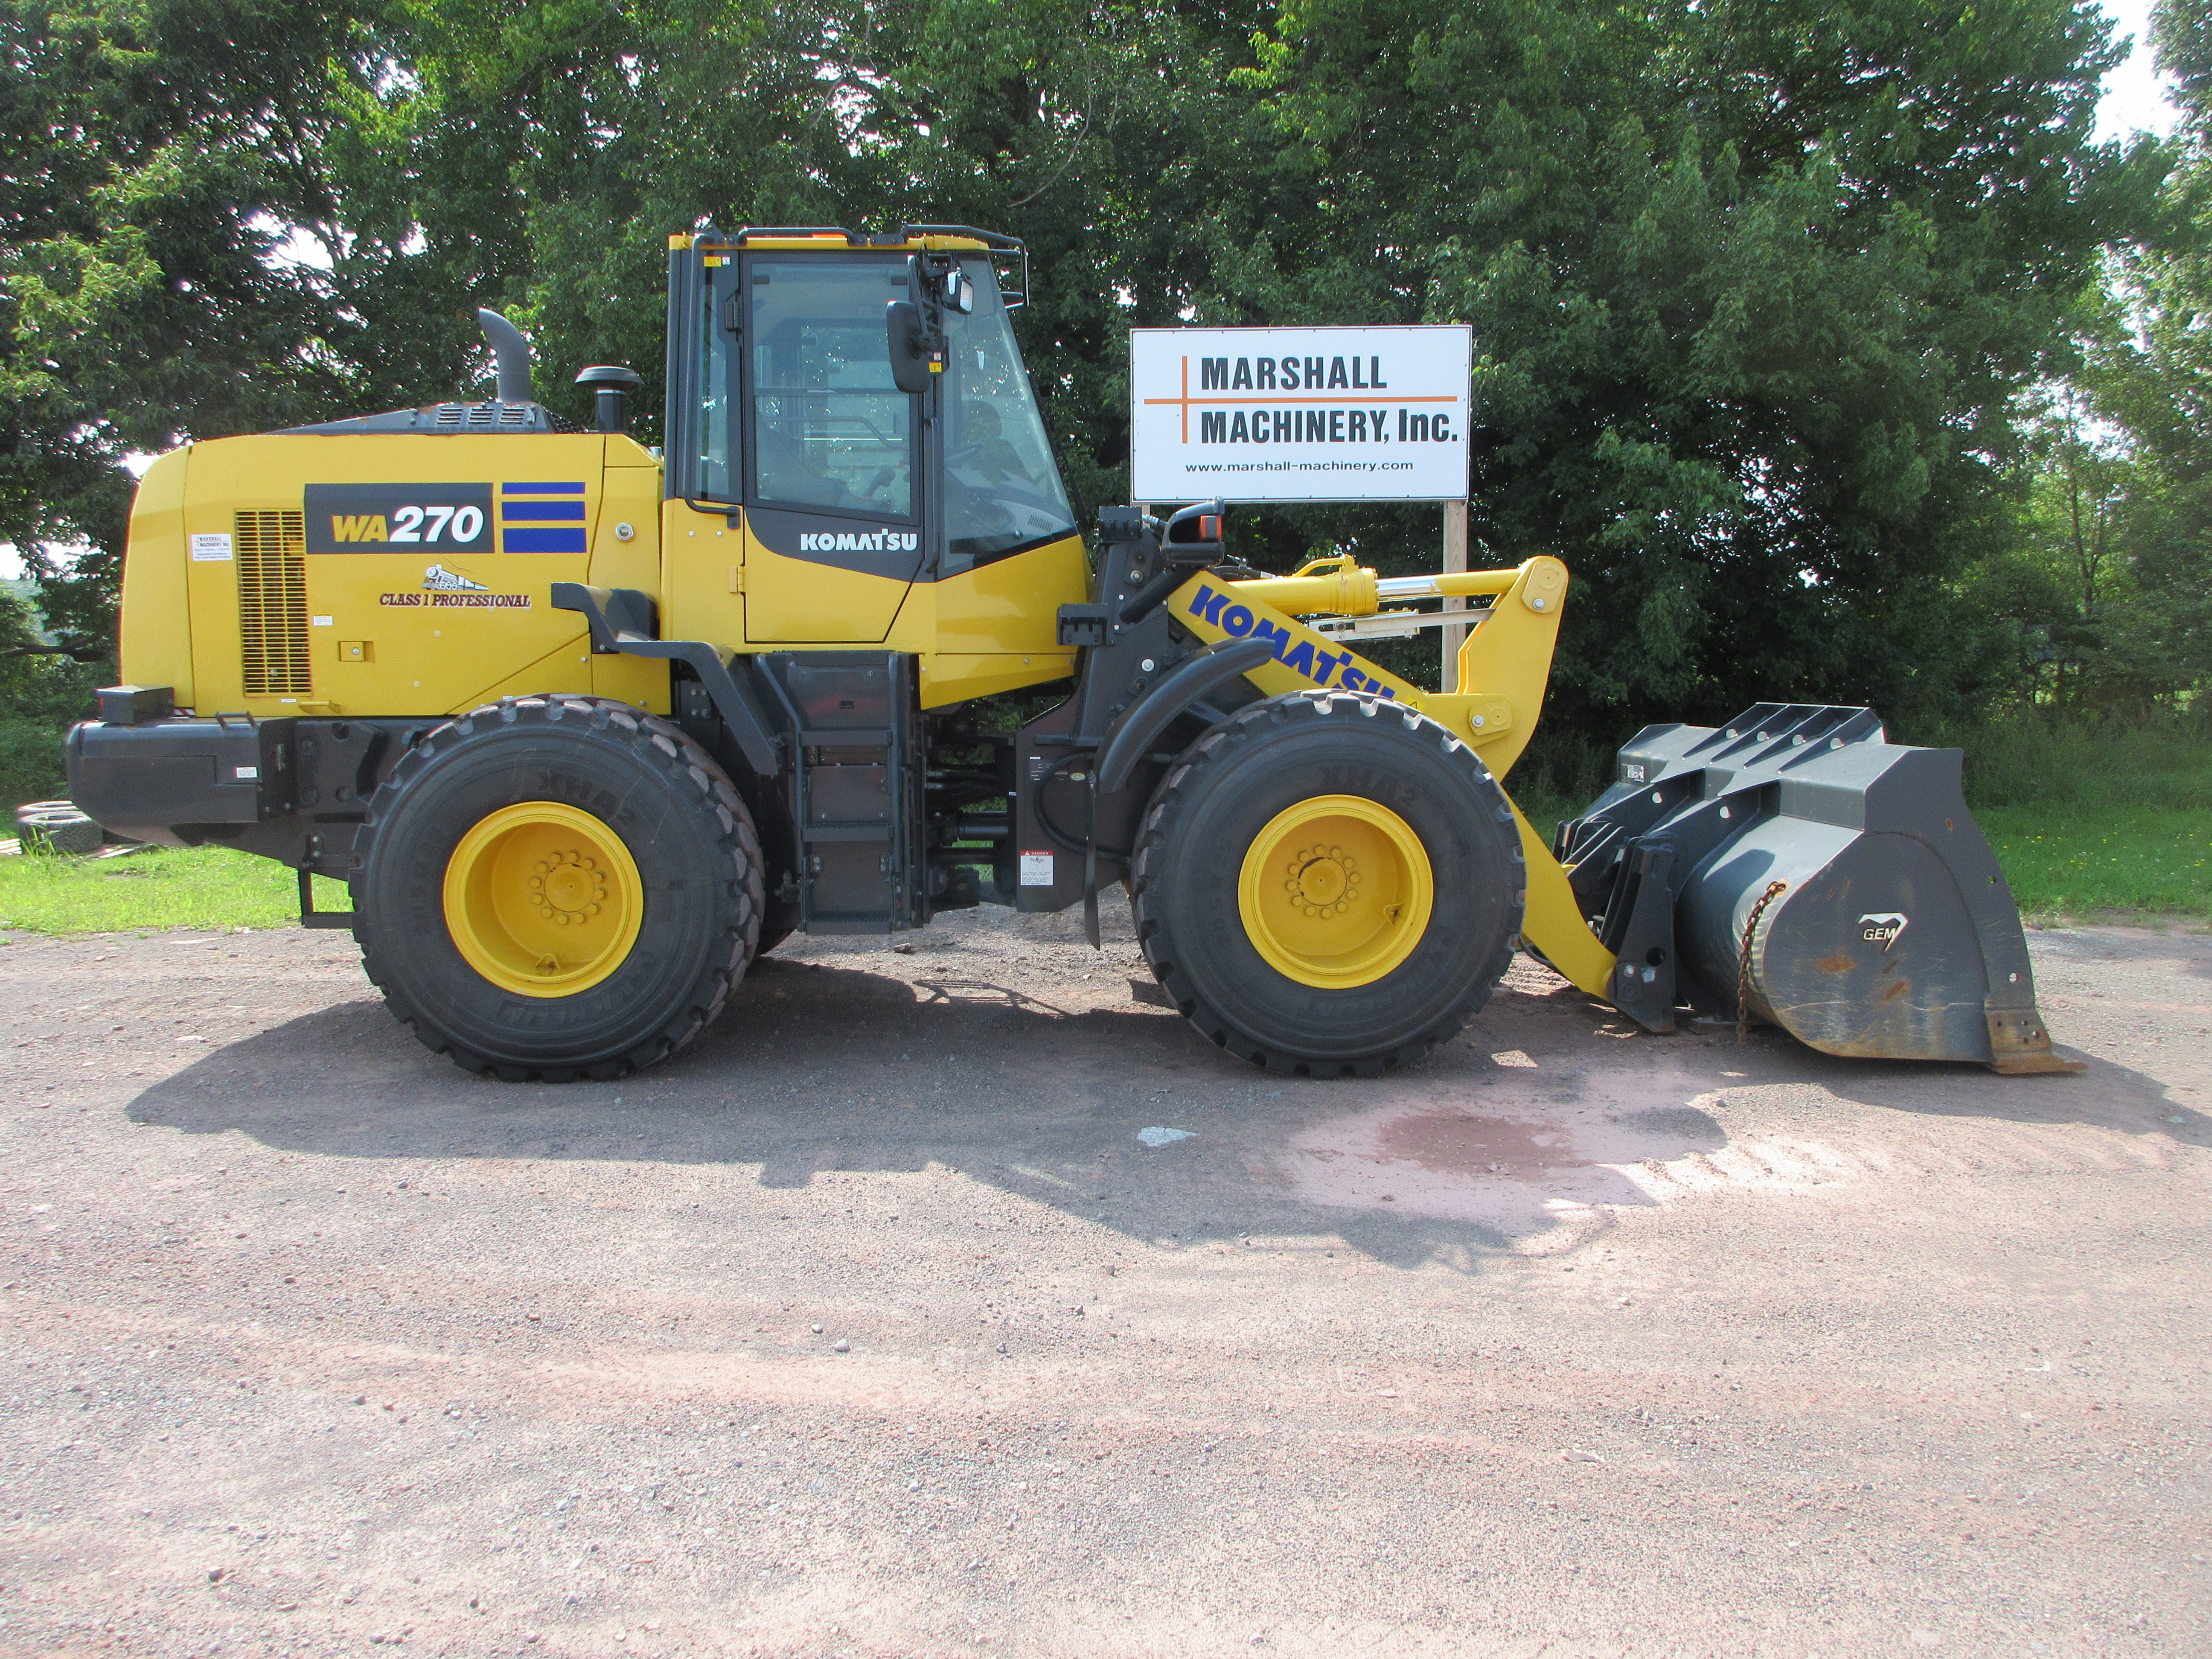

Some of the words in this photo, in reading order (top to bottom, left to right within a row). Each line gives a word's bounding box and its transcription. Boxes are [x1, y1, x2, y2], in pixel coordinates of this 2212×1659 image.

[1202, 356, 1387, 390] MARSHALL
[1202, 410, 1389, 445] MACHINERY,
[1399, 409, 1458, 442] Inc.
[1185, 461, 1413, 472] www.marshall-machinery.com
[332, 506, 483, 542] WA270
[800, 528, 917, 551] KOMATSU
[380, 594, 421, 606] CLASS
[423, 594, 430, 606] 1
[433, 594, 530, 607] PROFESSIONAL
[1863, 928, 1897, 940] GEM
